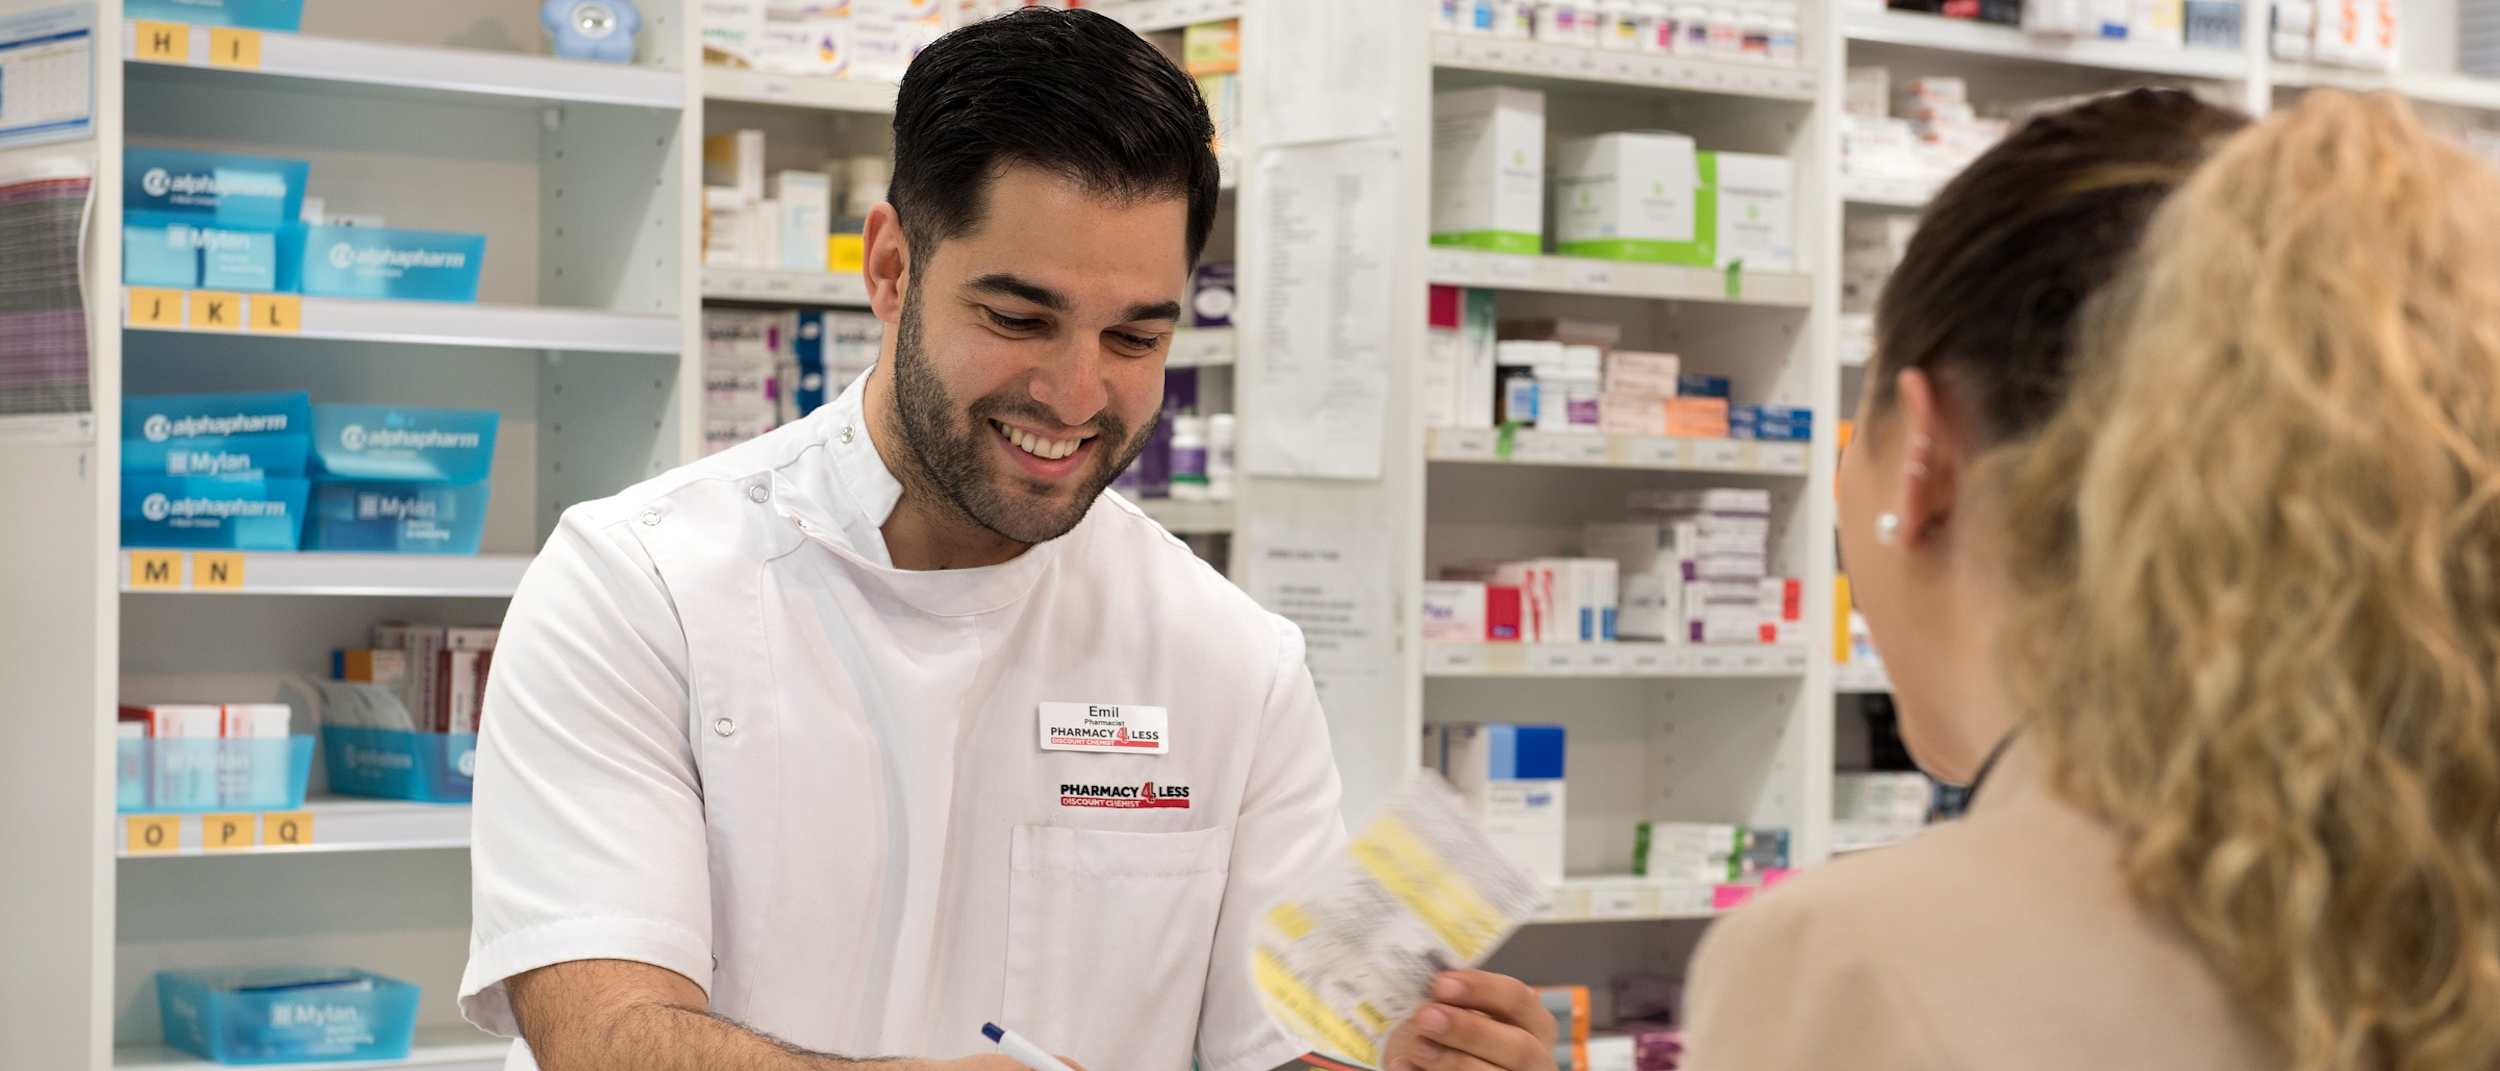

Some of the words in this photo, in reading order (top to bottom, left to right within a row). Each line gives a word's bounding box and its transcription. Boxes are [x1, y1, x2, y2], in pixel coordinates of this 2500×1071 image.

[153, 32, 171, 52] H
[231, 37, 240, 61] I
[353, 246, 466, 270] alphapharm
[151, 298, 161, 321] J
[207, 301, 223, 323] K
[269, 303, 281, 327] L
[171, 413, 287, 437] alphapharm
[366, 428, 480, 450] alphapharm
[191, 451, 251, 476] Mylan
[170, 497, 287, 520] alphapharm
[379, 496, 437, 520] Mylan
[144, 559, 170, 583] M
[208, 560, 228, 583] N
[1084, 718, 1125, 726] Pharmacist
[1089, 705, 1119, 718] Emil
[1050, 727, 1114, 738] PHARMACY
[1114, 726, 1130, 743] 4
[1131, 730, 1160, 740] LESS
[1087, 738, 1115, 746] CHEMIST
[1060, 784, 1140, 798] PHARMACY
[1141, 781, 1157, 804] 4
[1159, 786, 1190, 798] LESS
[1062, 797, 1105, 806] DISCOUNT
[1105, 799, 1141, 808] CHEMIST
[144, 823, 164, 847] O
[222, 822, 237, 844] P
[279, 820, 299, 844] Q
[294, 1002, 358, 1026] Mylan
